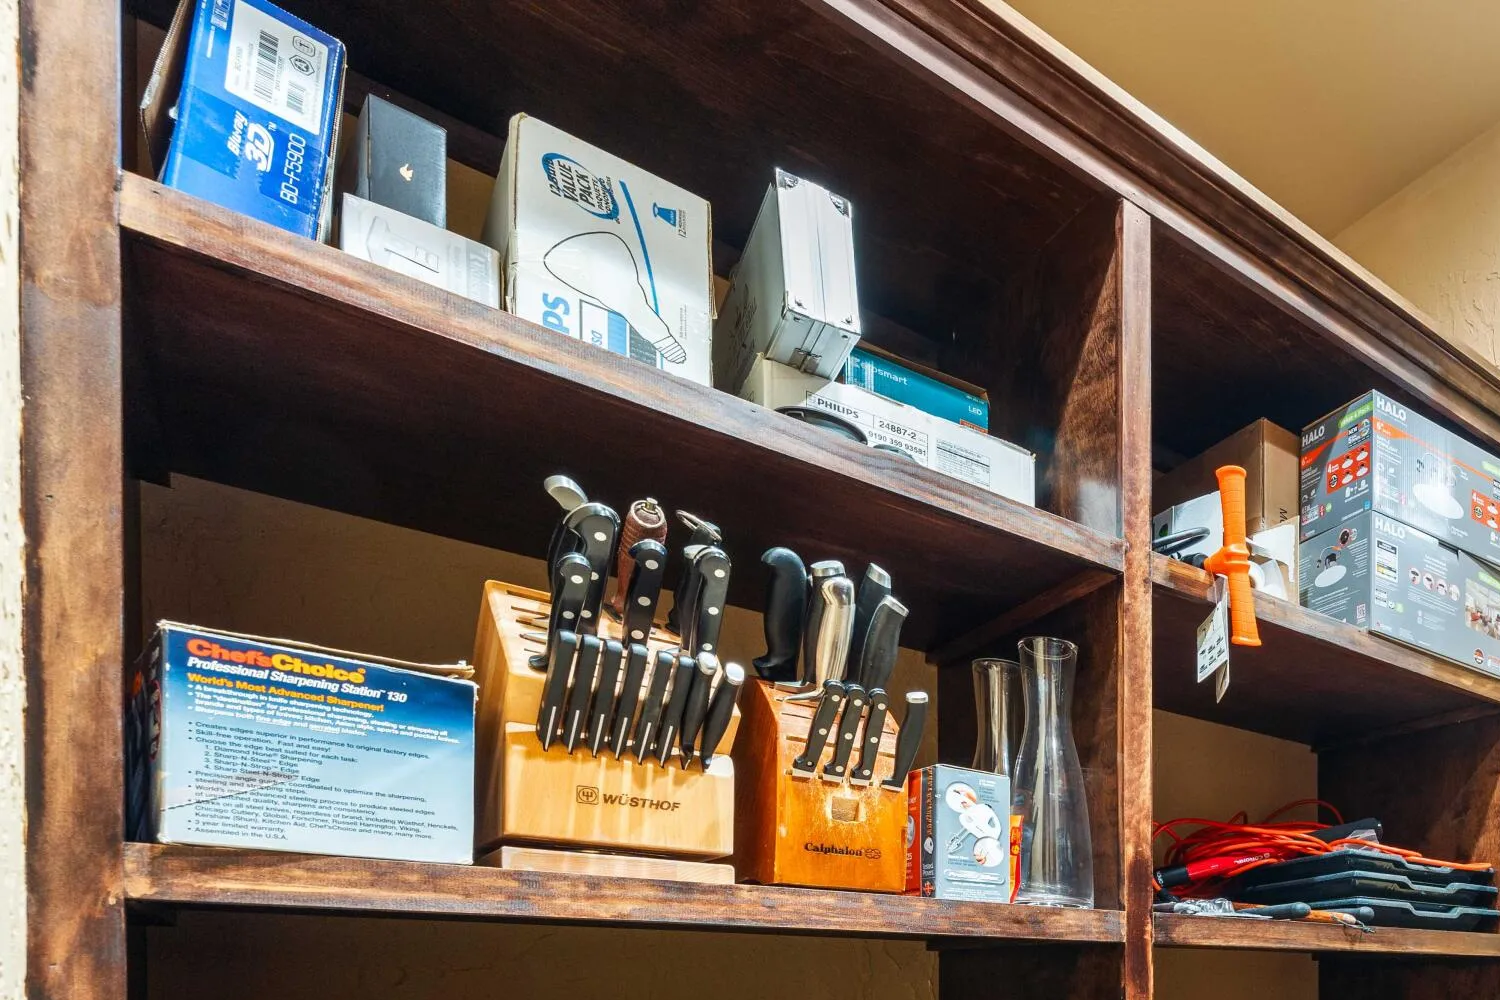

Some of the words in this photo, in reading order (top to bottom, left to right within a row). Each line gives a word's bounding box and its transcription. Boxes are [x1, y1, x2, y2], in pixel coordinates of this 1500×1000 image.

[280, 132, 306, 204] BD-F5900
[557, 160, 579, 202] VALUE
[575, 170, 596, 207] PACK
[816, 397, 860, 420] PHILIPS
[968, 404, 983, 416] LED
[1376, 396, 1408, 421] HALO
[1301, 425, 1326, 448] HALO
[1375, 517, 1407, 540] HALO
[187, 656, 269, 680] Professional
[270, 670, 338, 692] Sharpening
[387, 689, 407, 703] 130
[187, 672, 233, 687] World's
[236, 680, 265, 692] Most
[268, 685, 324, 702] Advanced
[326, 695, 383, 712] Sharpener!
[195, 729, 230, 738] Skill-free
[233, 734, 271, 745] operation.
[312, 744, 330, 752] easy!
[195, 736, 226, 745] Choose
[196, 721, 227, 730] Creates
[229, 726, 253, 735] edges
[255, 729, 286, 739] superior
[298, 735, 345, 747] performance
[355, 743, 381, 752] original
[383, 747, 406, 756] factory
[214, 746, 250, 755] Diamond
[280, 754, 322, 764] Sharpening
[195, 771, 232, 779] Precision
[235, 775, 256, 783] angle
[213, 765, 237, 773] Sharp
[280, 766, 299, 774] Edge
[249, 790, 286, 799] advanced
[602, 792, 681, 812] WÜSTHOF
[194, 827, 239, 835] Assembled
[804, 842, 863, 858] Calphalon
